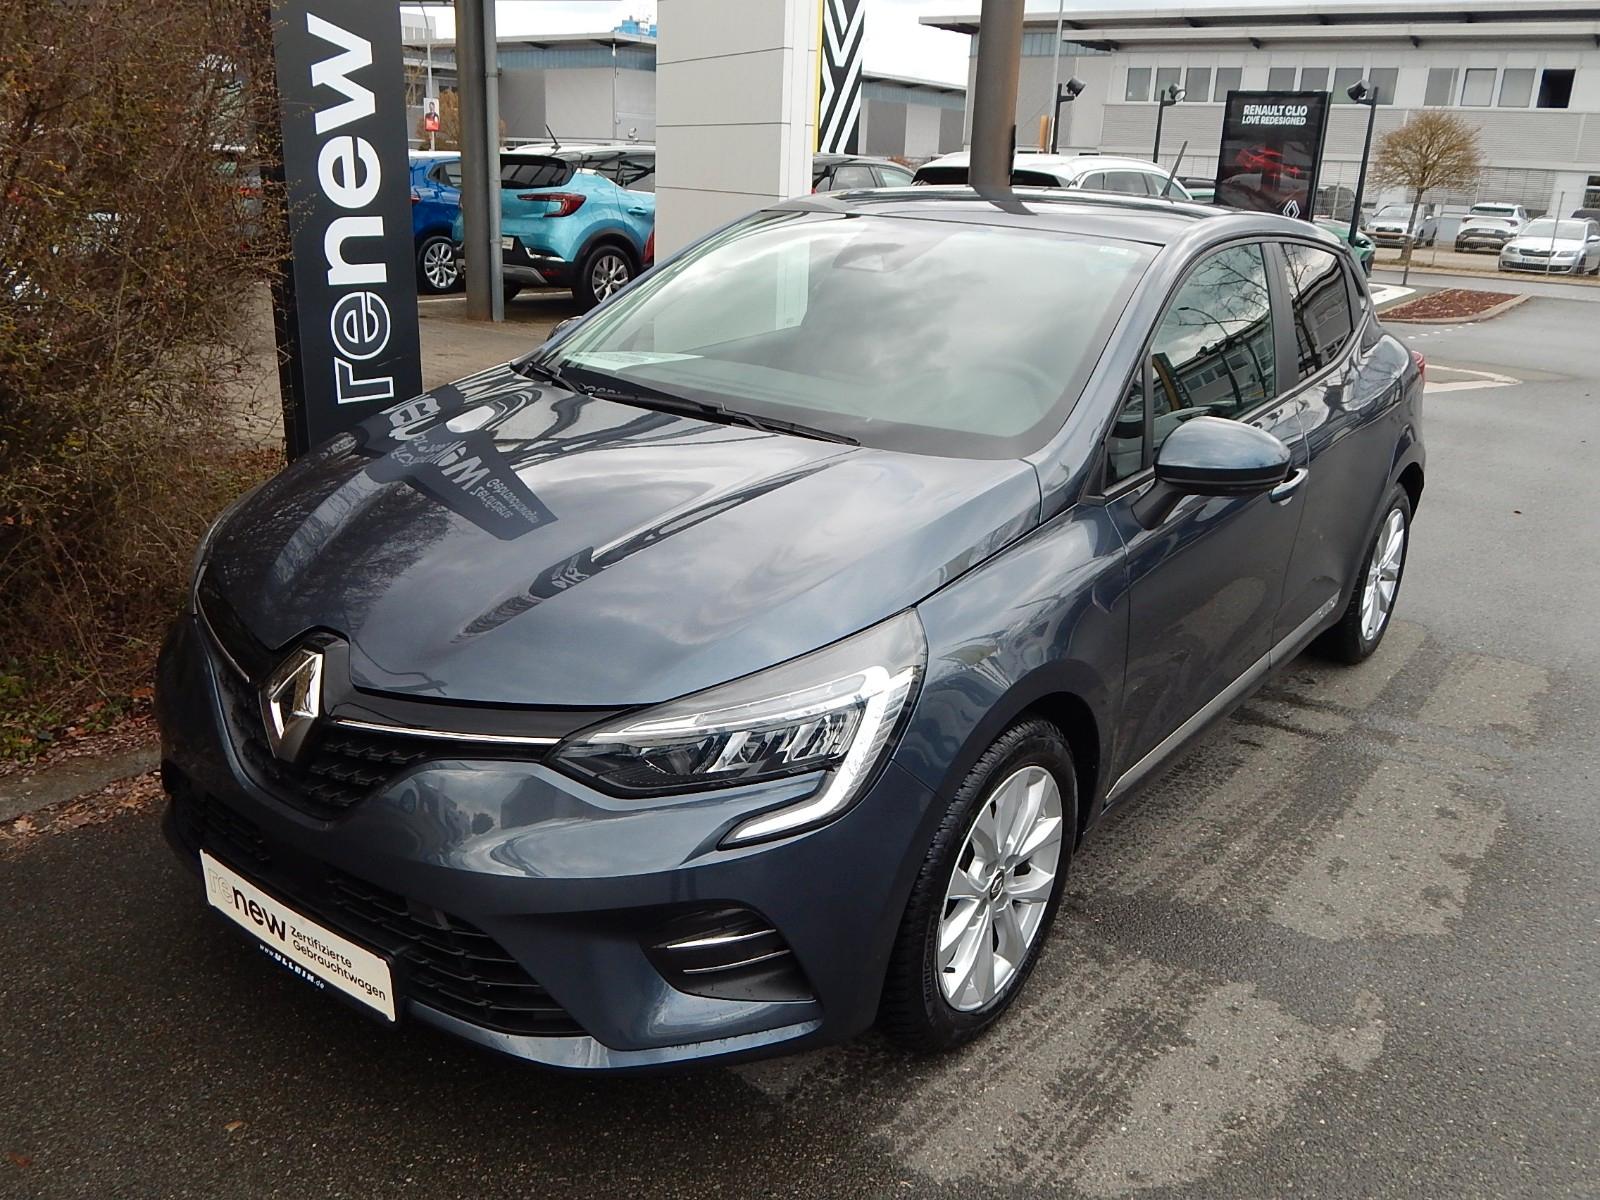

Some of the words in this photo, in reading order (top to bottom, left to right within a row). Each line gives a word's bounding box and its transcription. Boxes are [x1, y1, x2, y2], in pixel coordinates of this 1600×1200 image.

[1241, 115, 1261, 125] LOVE
[1260, 116, 1307, 126] REDESIGNED
[1242, 104, 1285, 116] RENAULT
[1285, 105, 1309, 116] CLIO
[306, 12, 395, 404] renew
[207, 867, 287, 942] renew
[289, 924, 353, 969] Zertifizierte
[292, 939, 387, 1001] Gebrauchtwagen
